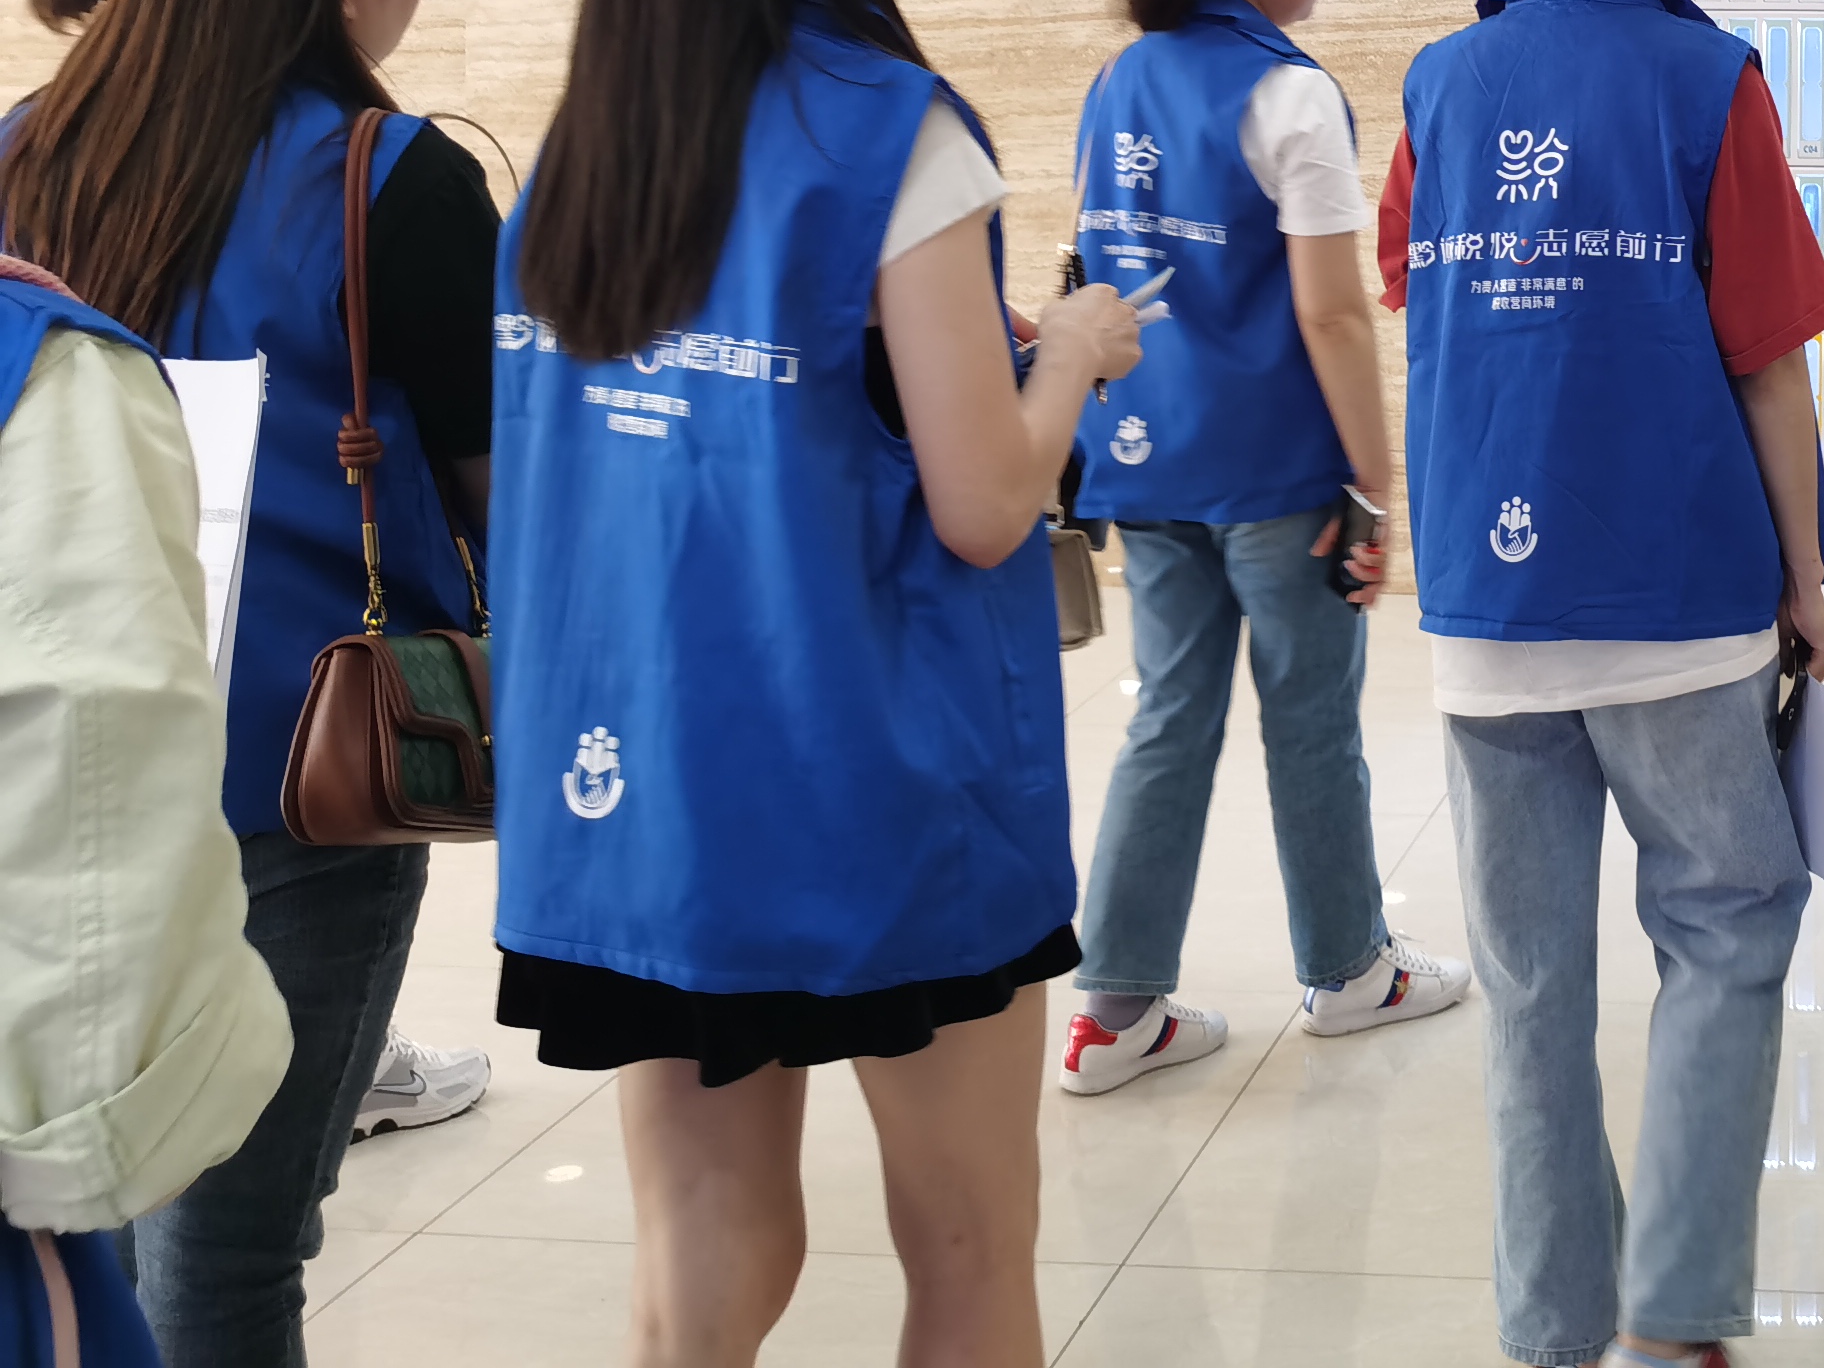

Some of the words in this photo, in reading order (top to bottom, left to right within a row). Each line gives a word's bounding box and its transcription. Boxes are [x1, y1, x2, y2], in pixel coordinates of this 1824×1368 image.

[1803, 145, 1818, 153] C04
[1491, 296, 1555, 310] 税收营商环境
